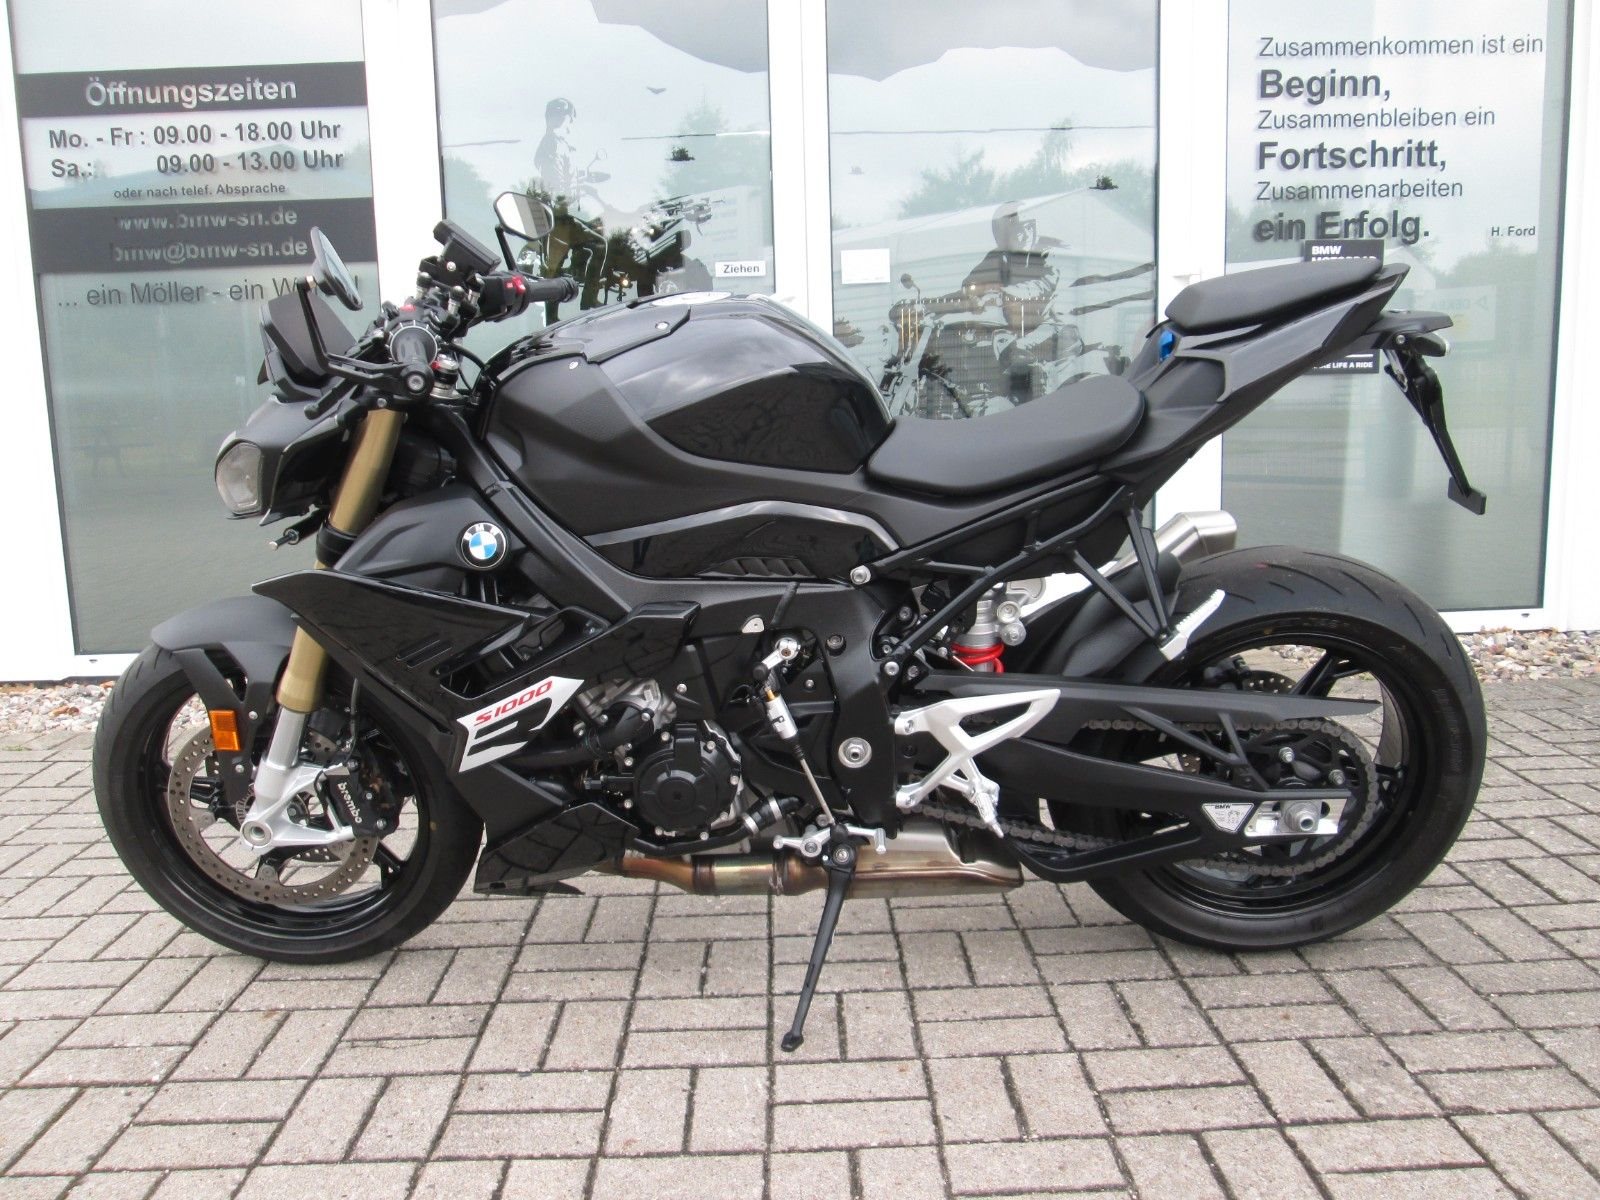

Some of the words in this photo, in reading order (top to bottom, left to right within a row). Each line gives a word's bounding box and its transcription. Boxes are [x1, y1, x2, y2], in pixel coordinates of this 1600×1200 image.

[1259, 36, 1474, 57] Zusammenkommen
[1482, 34, 1505, 53] ist
[1512, 34, 1543, 53] ein
[85, 77, 297, 109] Öffnungszeiten
[1260, 69, 1391, 105] Beginn,
[1258, 107, 1457, 129] Zusammenbleiben
[1464, 106, 1495, 126] ein
[48, 129, 89, 149] Mo.
[153, 124, 212, 145] 09.00
[235, 122, 293, 142] 18.00
[300, 120, 341, 140] Uhr
[50, 159, 92, 178] Sa.:
[156, 154, 215, 174] 09.00
[238, 152, 296, 172] 13.00
[303, 149, 344, 169] Uhr
[1258, 140, 1446, 170] Fortschritt,
[113, 188, 143, 199] oder
[147, 186, 177, 198] nach
[181, 184, 213, 197] telef.
[216, 183, 286, 198] Absprache
[1256, 179, 1463, 201] Zusammenarbeiten
[1253, 213, 1306, 241] ein
[1318, 209, 1430, 245] Erfolg.
[1491, 226, 1502, 237] H.
[1508, 225, 1536, 237] Ford
[1312, 245, 1342, 255] BMW
[723, 264, 760, 274] Ziehen
[86, 285, 121, 306] ein
[130, 281, 203, 304] Möller
[229, 280, 264, 300] ein
[1332, 361, 1349, 369] LIFE
[1349, 361, 1355, 369] A
[474, 680, 553, 727] S1000
[337, 781, 363, 824] brembo
